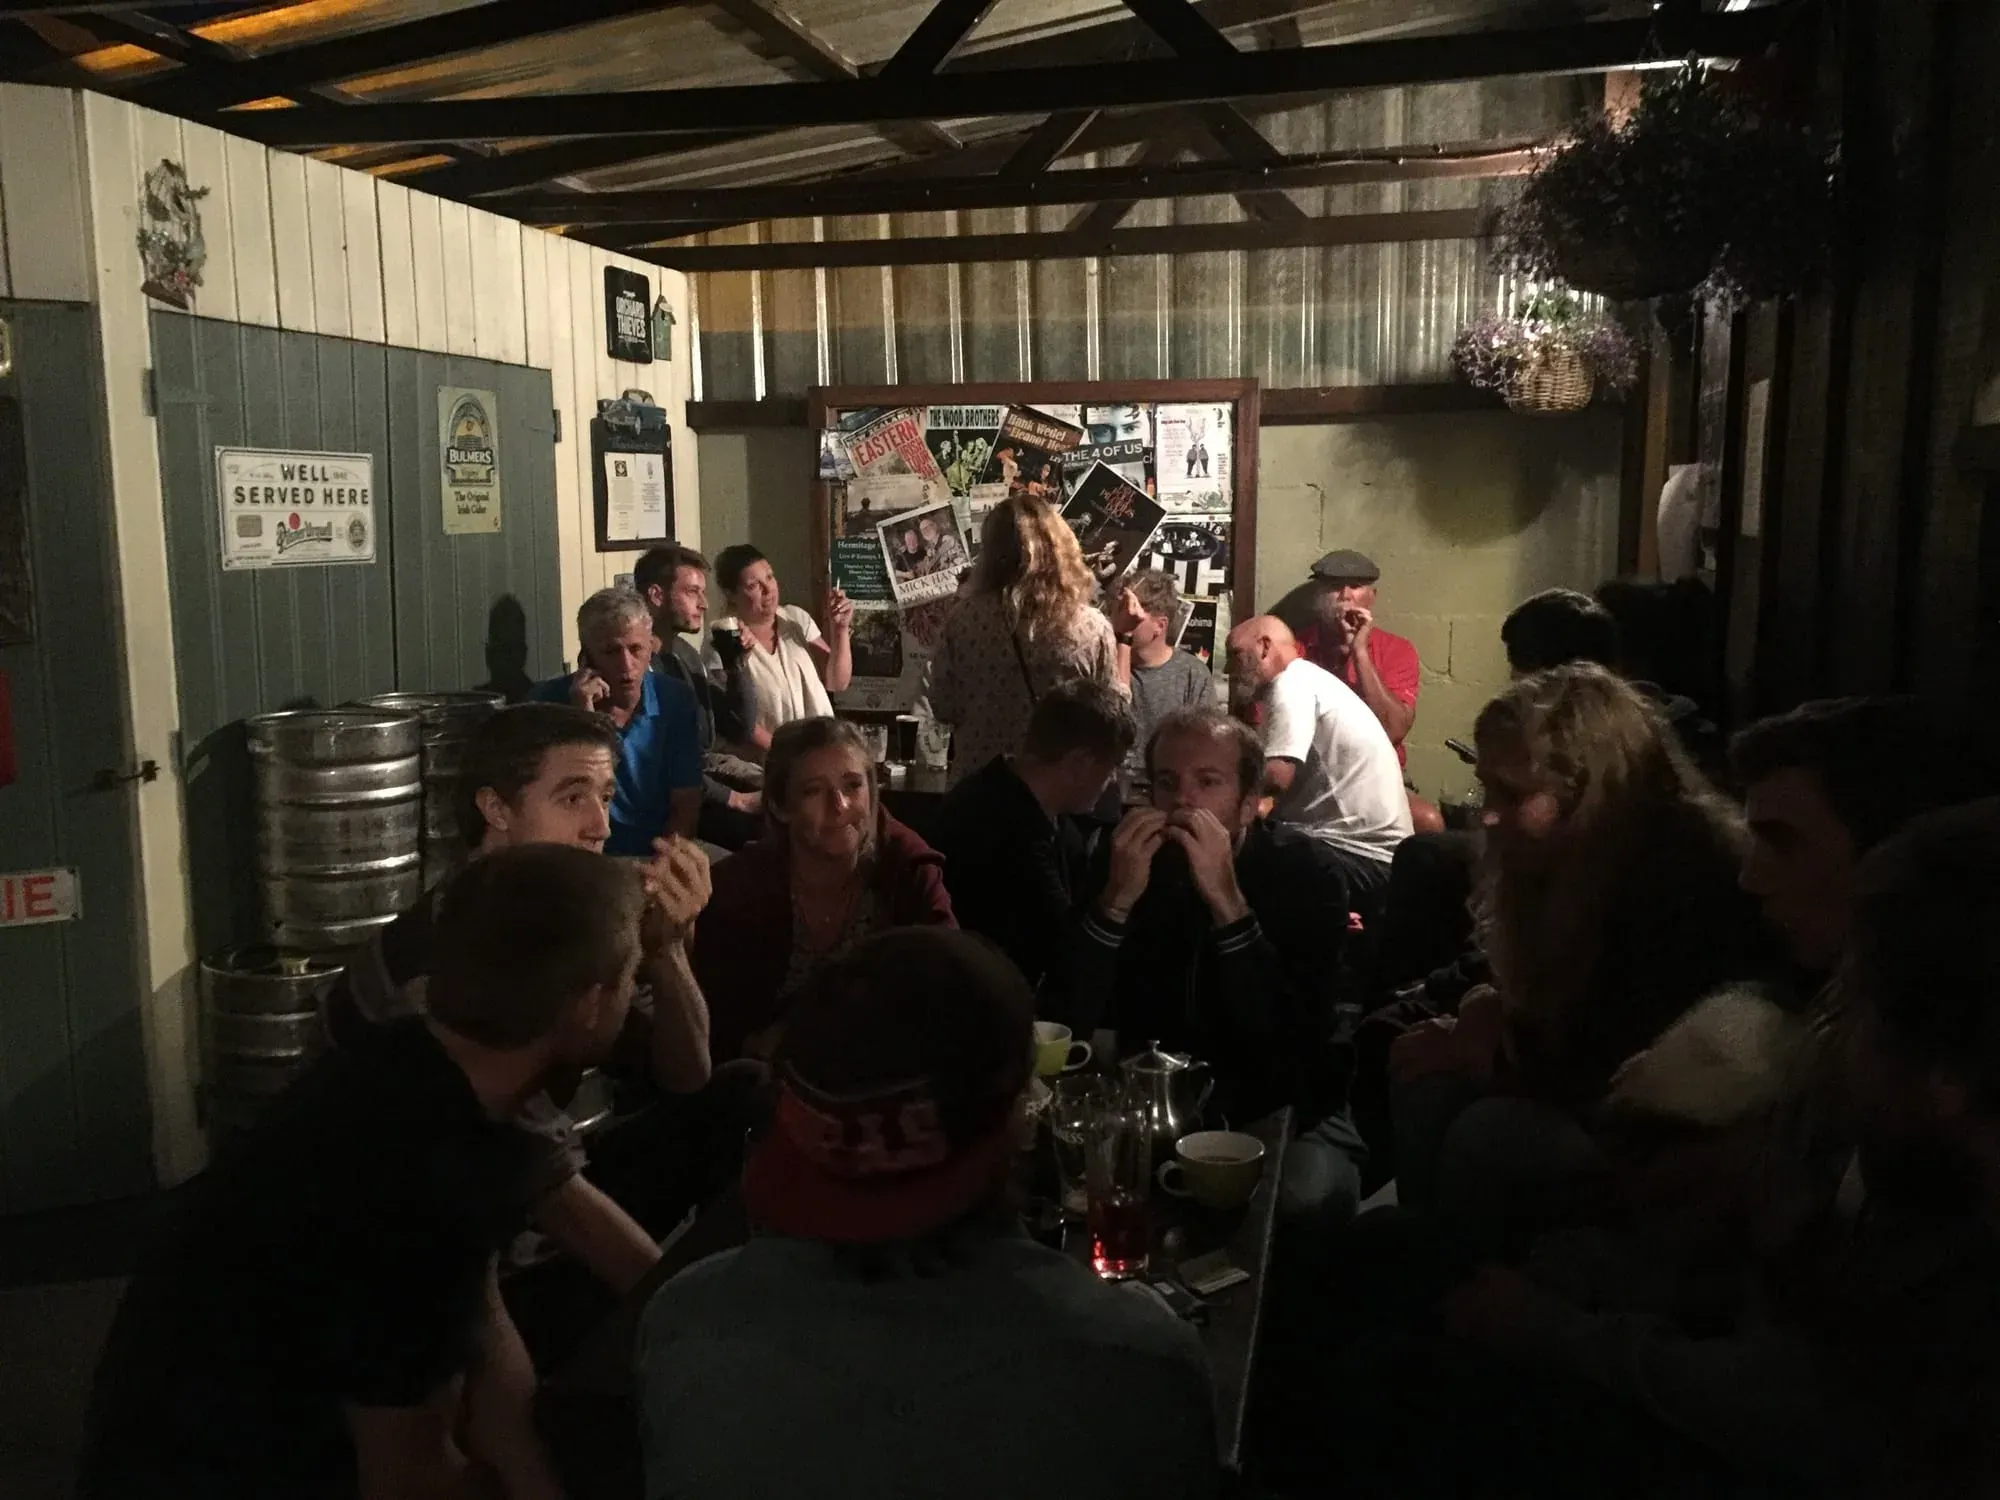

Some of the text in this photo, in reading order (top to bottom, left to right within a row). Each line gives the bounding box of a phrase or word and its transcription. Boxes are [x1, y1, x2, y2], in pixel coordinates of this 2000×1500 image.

[617, 313, 646, 339] THIEVES
[930, 409, 999, 426] THE WOOD BROTHERS
[853, 418, 921, 466] EASTERN
[449, 449, 492, 464] BULMERS
[1062, 443, 1143, 461] THE 4 OF US
[280, 463, 329, 482] WELL
[234, 486, 370, 505] SERVED HERE
[838, 541, 876, 550] Hermitage
[899, 578, 929, 593] MICK
